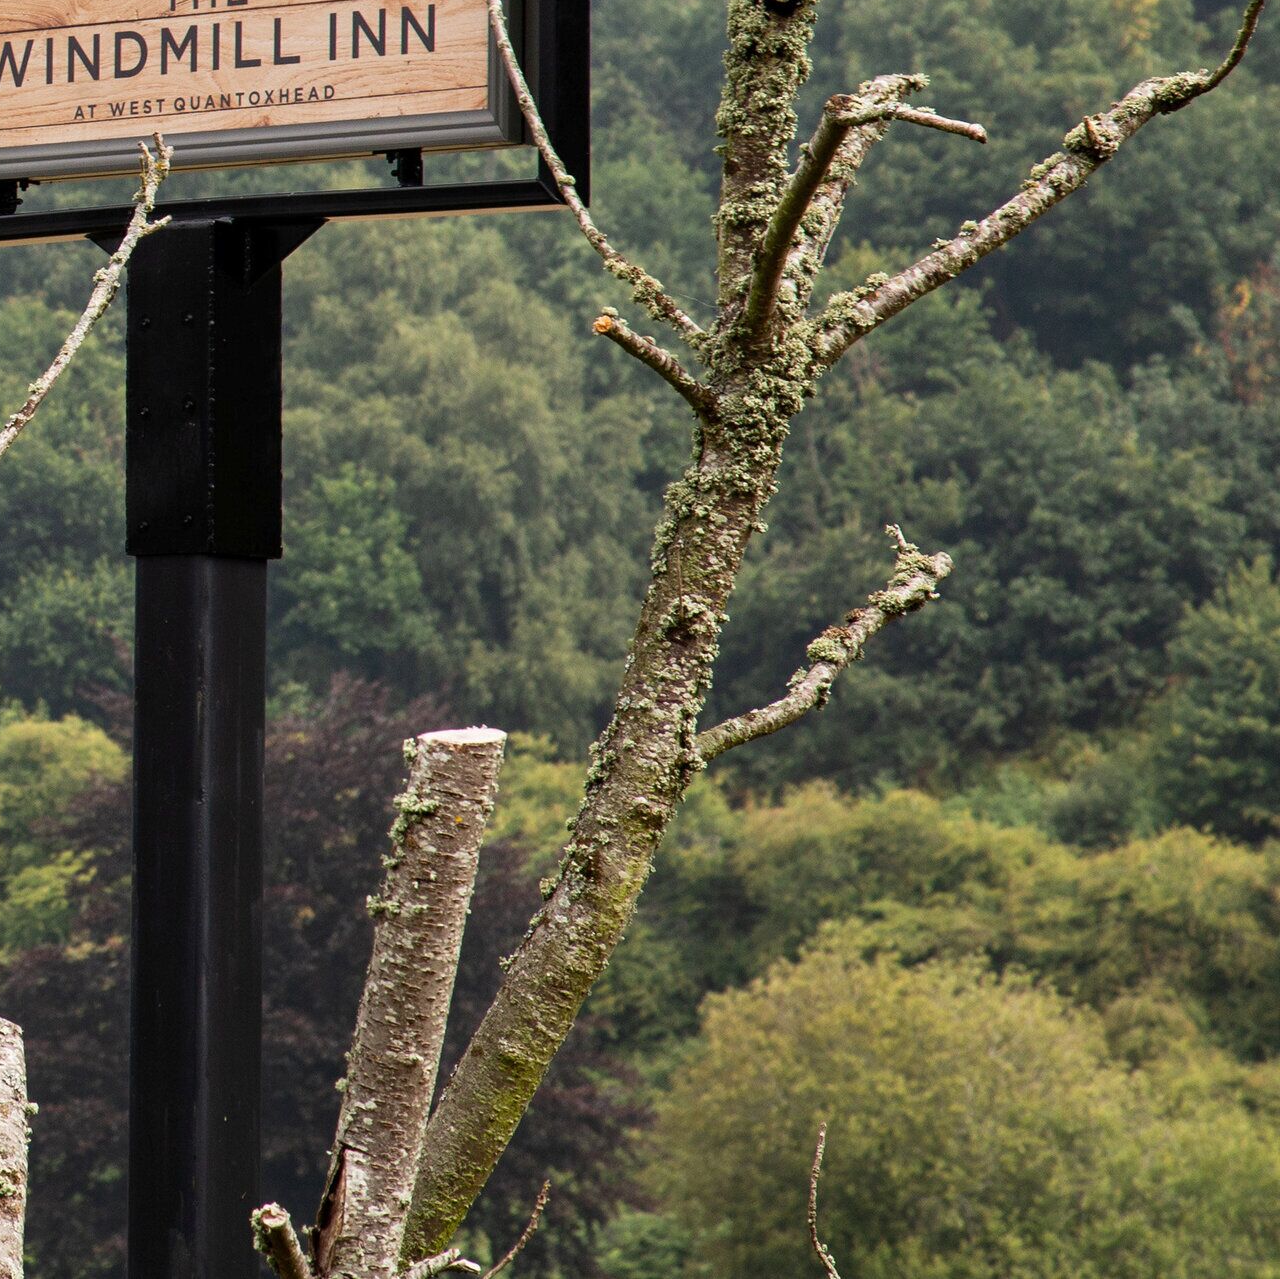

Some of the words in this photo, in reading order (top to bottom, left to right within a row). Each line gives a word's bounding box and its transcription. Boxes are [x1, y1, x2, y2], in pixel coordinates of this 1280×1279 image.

[328, 4, 436, 61] INN
[73, 103, 98, 120] AT
[108, 98, 165, 117] WEST
[173, 84, 336, 112] QUANTOXHEAD
